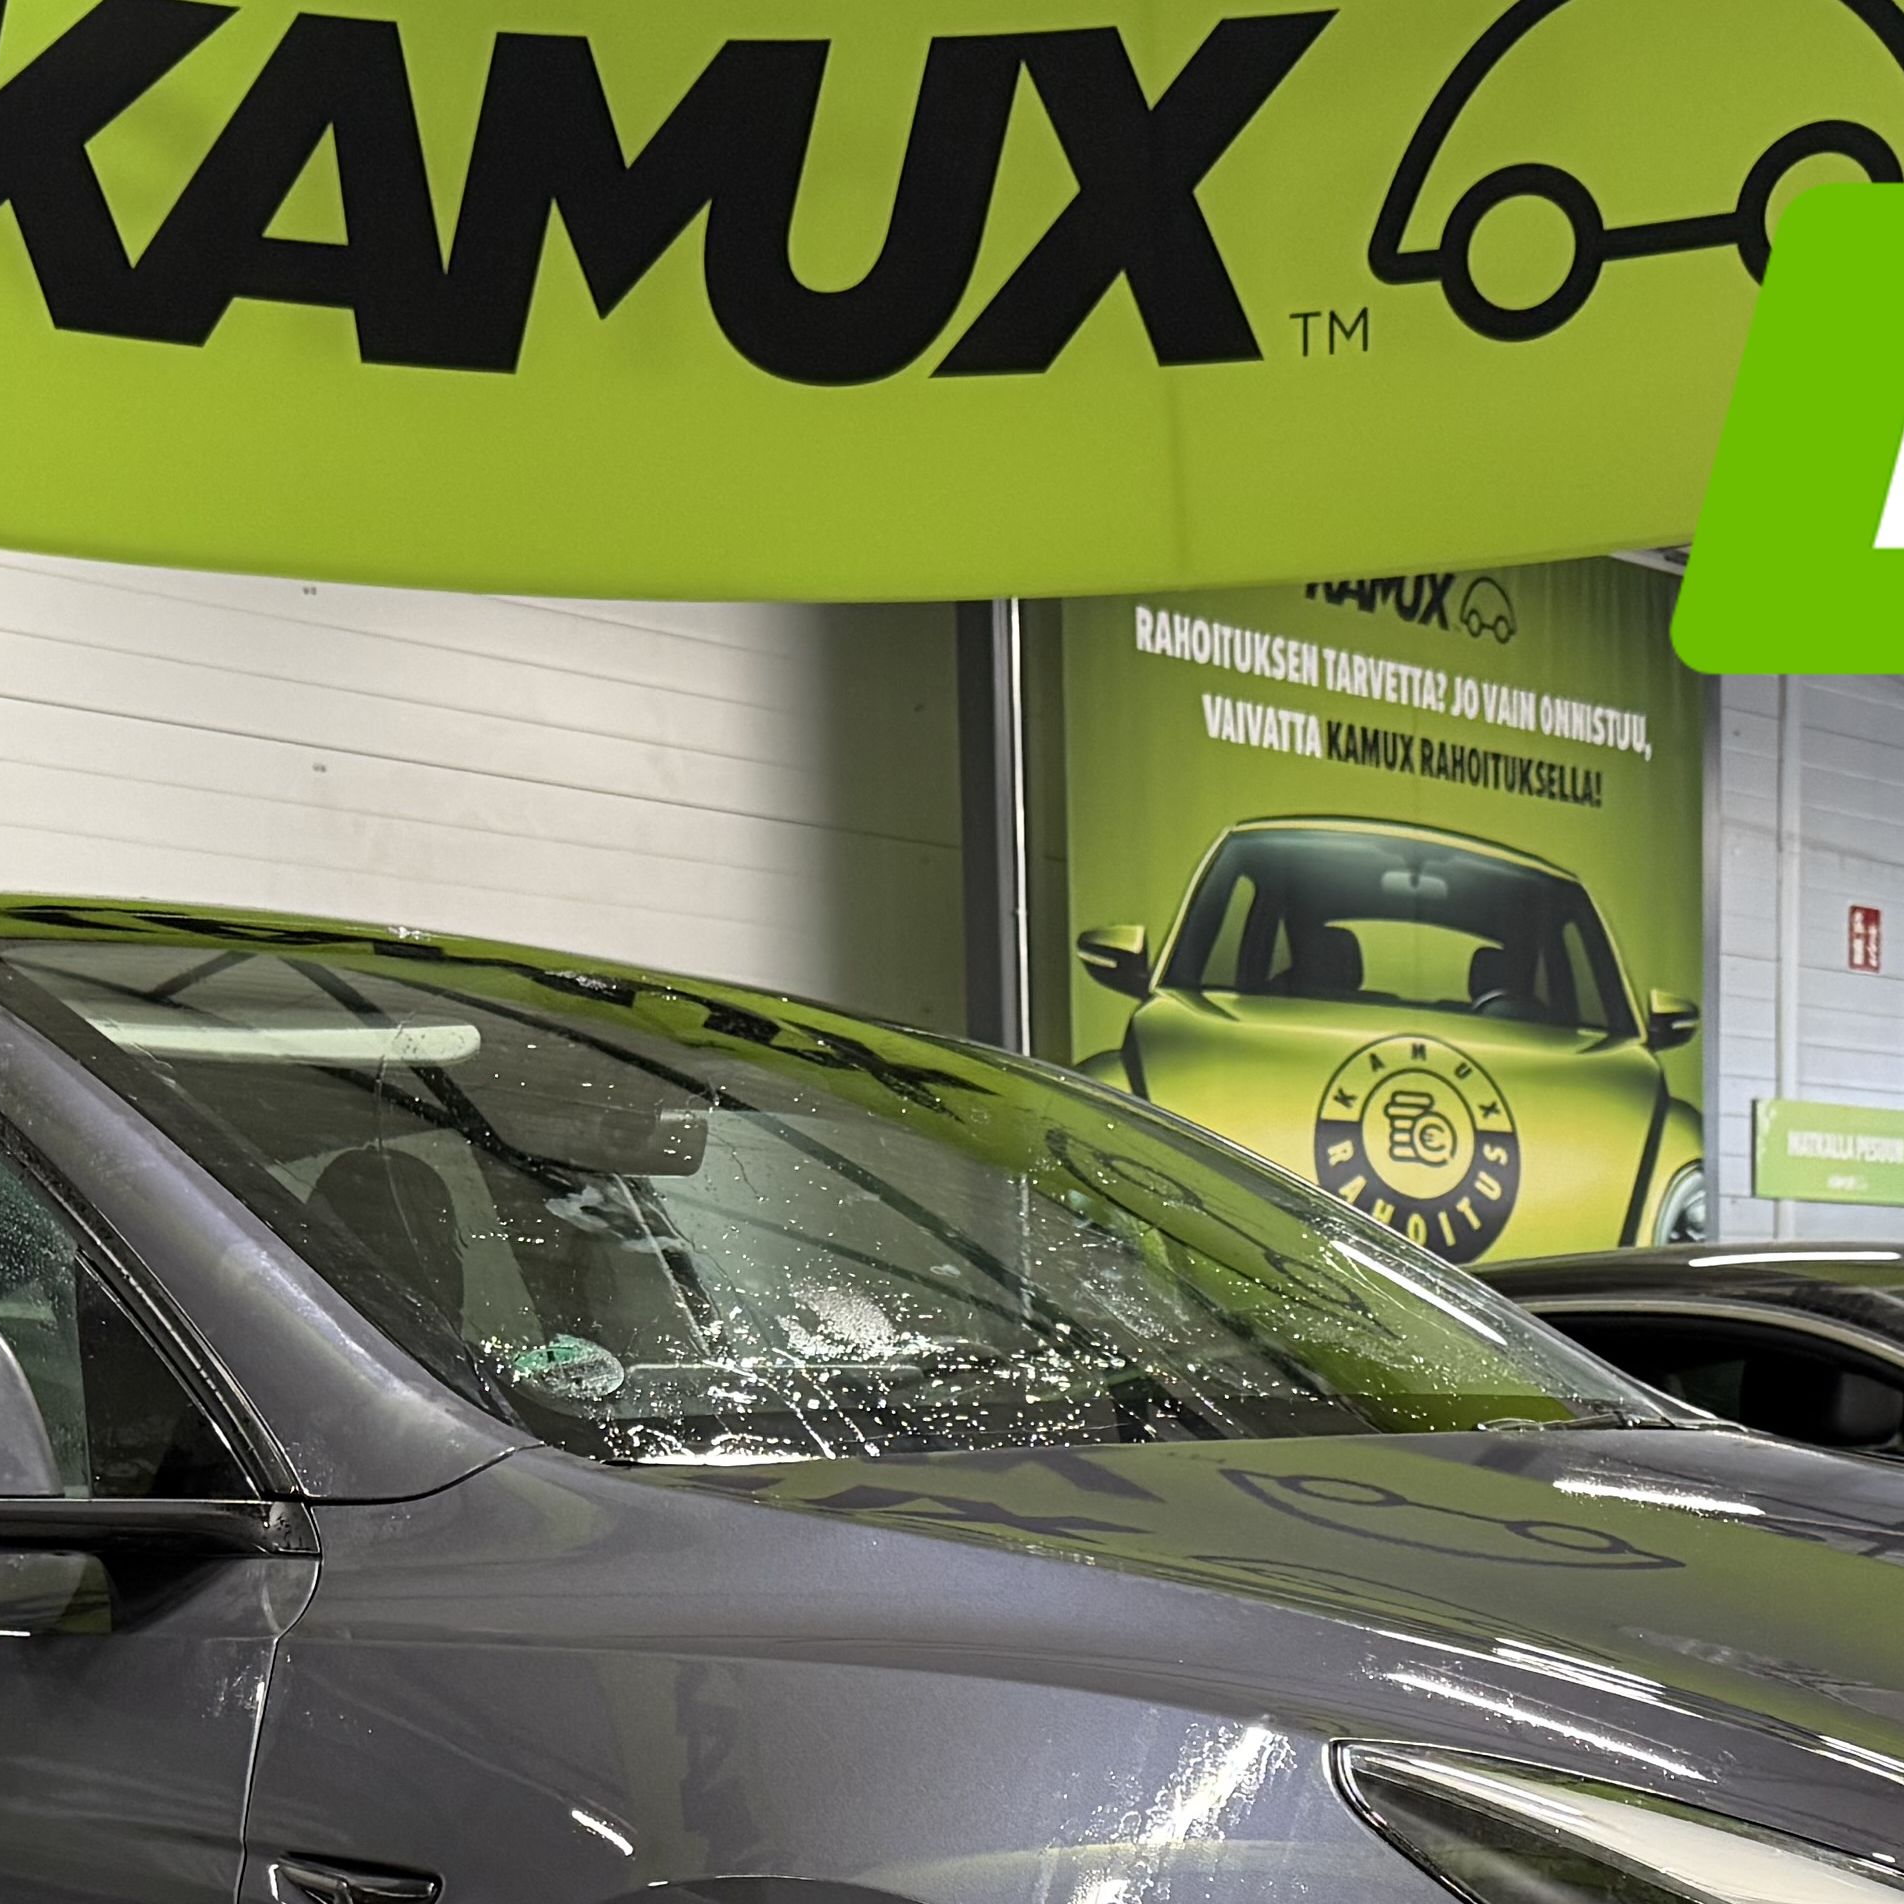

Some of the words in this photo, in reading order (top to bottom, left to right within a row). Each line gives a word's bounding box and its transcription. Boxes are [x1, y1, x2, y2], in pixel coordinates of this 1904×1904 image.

[1291, 308, 1368, 356] TM
[1135, 605, 1319, 688] RAHOITUKSEN
[1322, 647, 1448, 712] TARVETTA?
[1452, 677, 1479, 720] JO
[1481, 683, 1537, 733] VAIN
[1540, 694, 1653, 761] ONNISTUU,
[1202, 694, 1322, 759] VAIVATTA
[1327, 719, 1416, 775] KAMUX
[1419, 737, 1603, 808] RAHOITUKSELLA!
[1332, 1043, 1501, 1120] KAMUX
[1327, 1140, 1509, 1248] RAHOITUS
